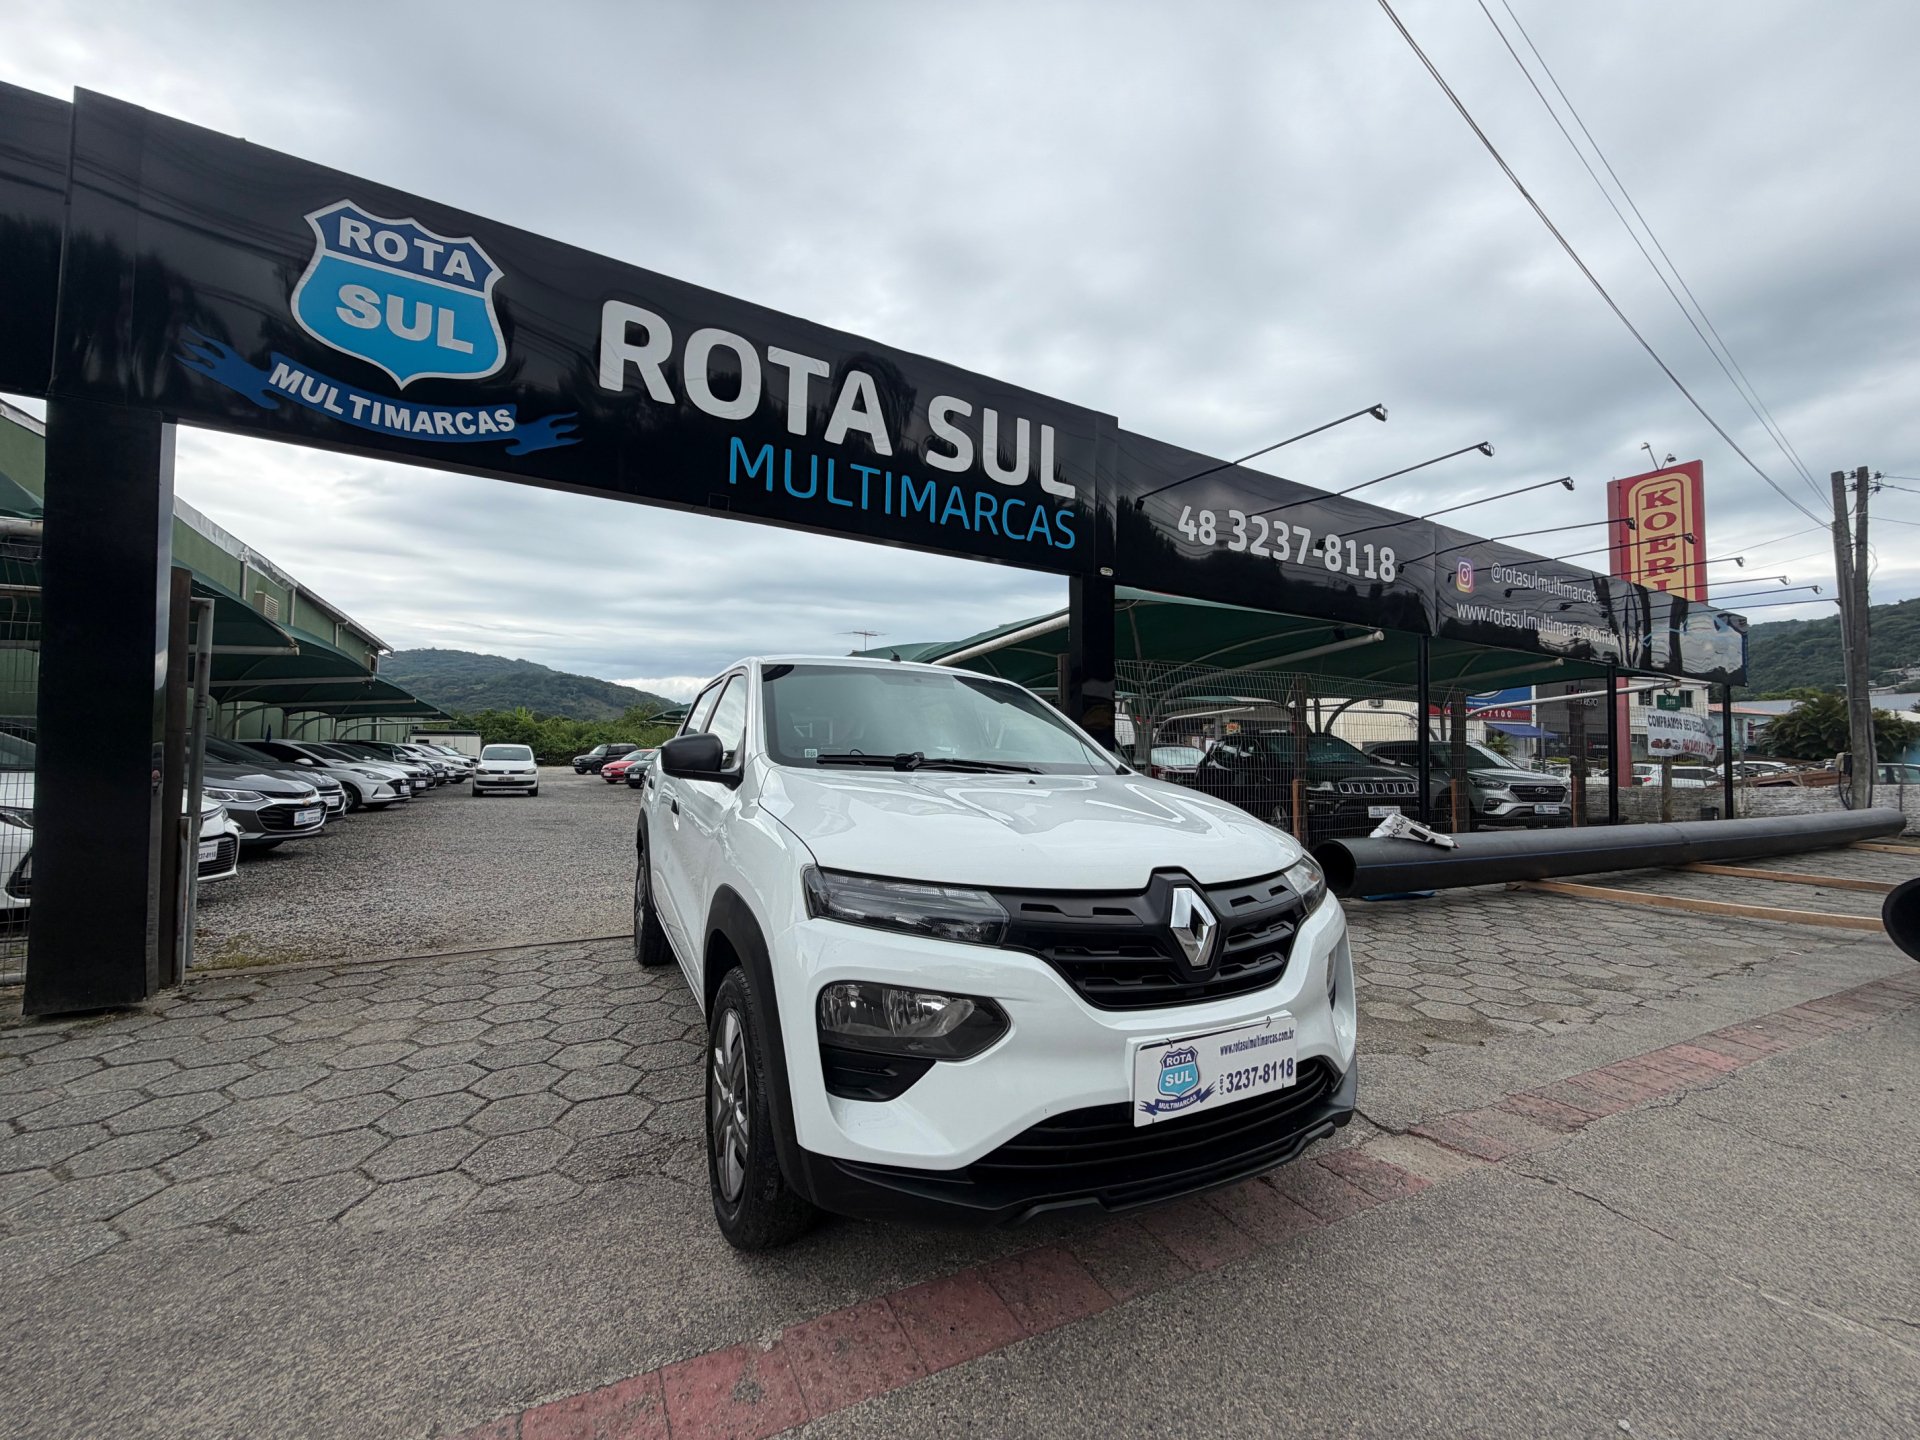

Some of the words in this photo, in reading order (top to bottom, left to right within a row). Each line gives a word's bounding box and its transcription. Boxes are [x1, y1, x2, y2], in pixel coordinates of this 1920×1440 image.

[338, 216, 476, 283] ROTA
[335, 284, 474, 354] SUL
[268, 361, 516, 436] MULTIMARCAS
[598, 299, 893, 456] ROTA
[925, 395, 1076, 499] SUL
[729, 436, 1076, 550] MULTIMARCAS
[1178, 505, 1217, 546] 48
[1228, 509, 1396, 583] 3237-8118
[1491, 561, 1597, 604] @rotasulmultimarcas
[1456, 602, 1620, 647] www.rotasulmultimarcas.com.br
[1165, 1053, 1192, 1067] ROTA
[1220, 1027, 1295, 1056] www.rotasulmultimarcas.com.br
[1165, 1070, 1193, 1087] SUL
[1226, 1057, 1294, 1094] 3237-8118
[1158, 1094, 1197, 1110] MULTIMARCAS
